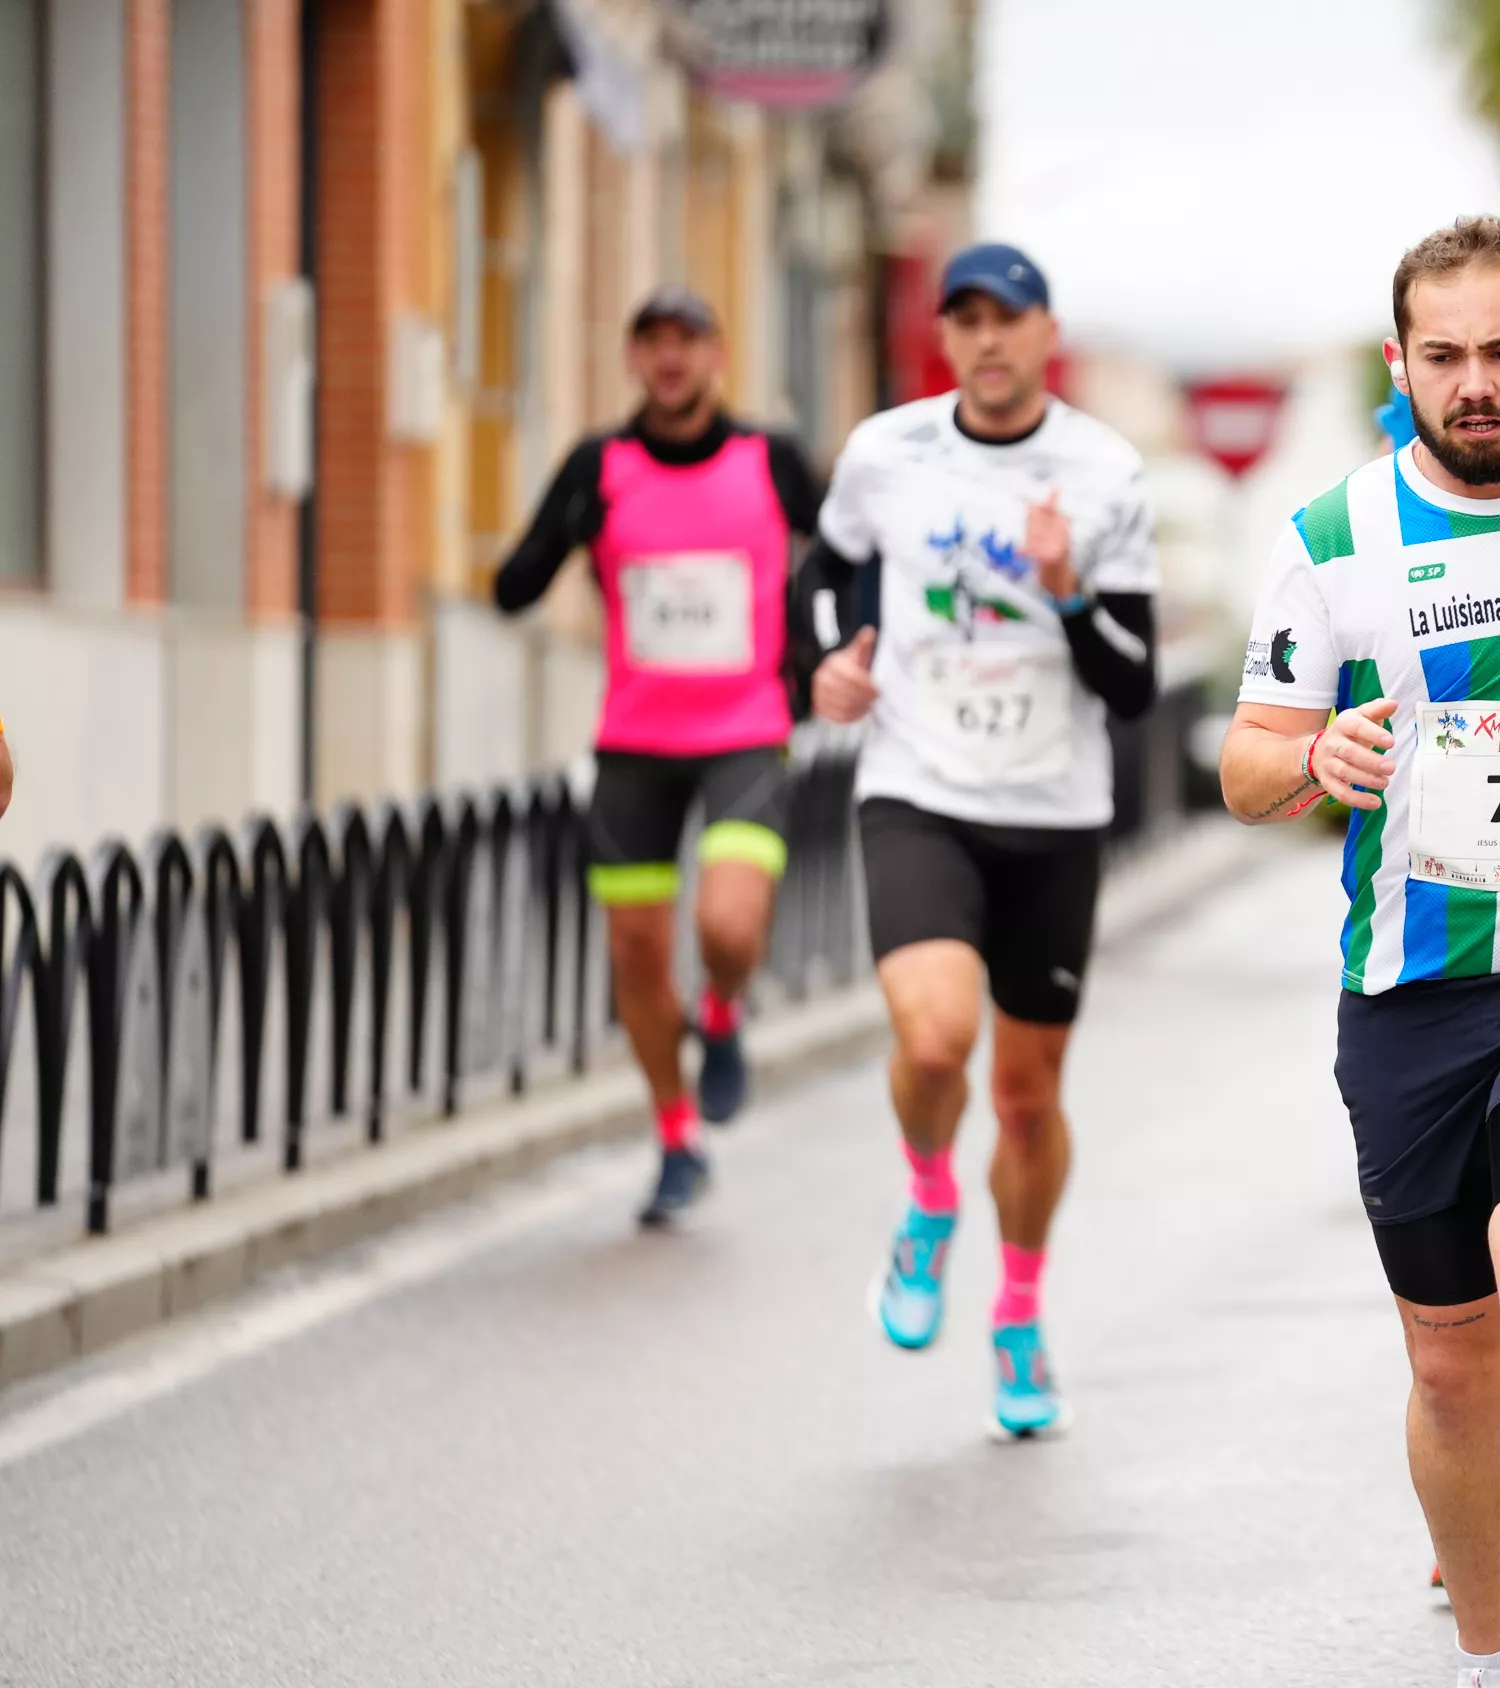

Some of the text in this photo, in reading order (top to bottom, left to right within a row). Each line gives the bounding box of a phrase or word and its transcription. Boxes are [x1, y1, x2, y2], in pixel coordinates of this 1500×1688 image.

[1427, 567, 1441, 577] SP
[1409, 607, 1430, 637] La
[955, 693, 1035, 739] 627
[1474, 713, 1497, 740] X
